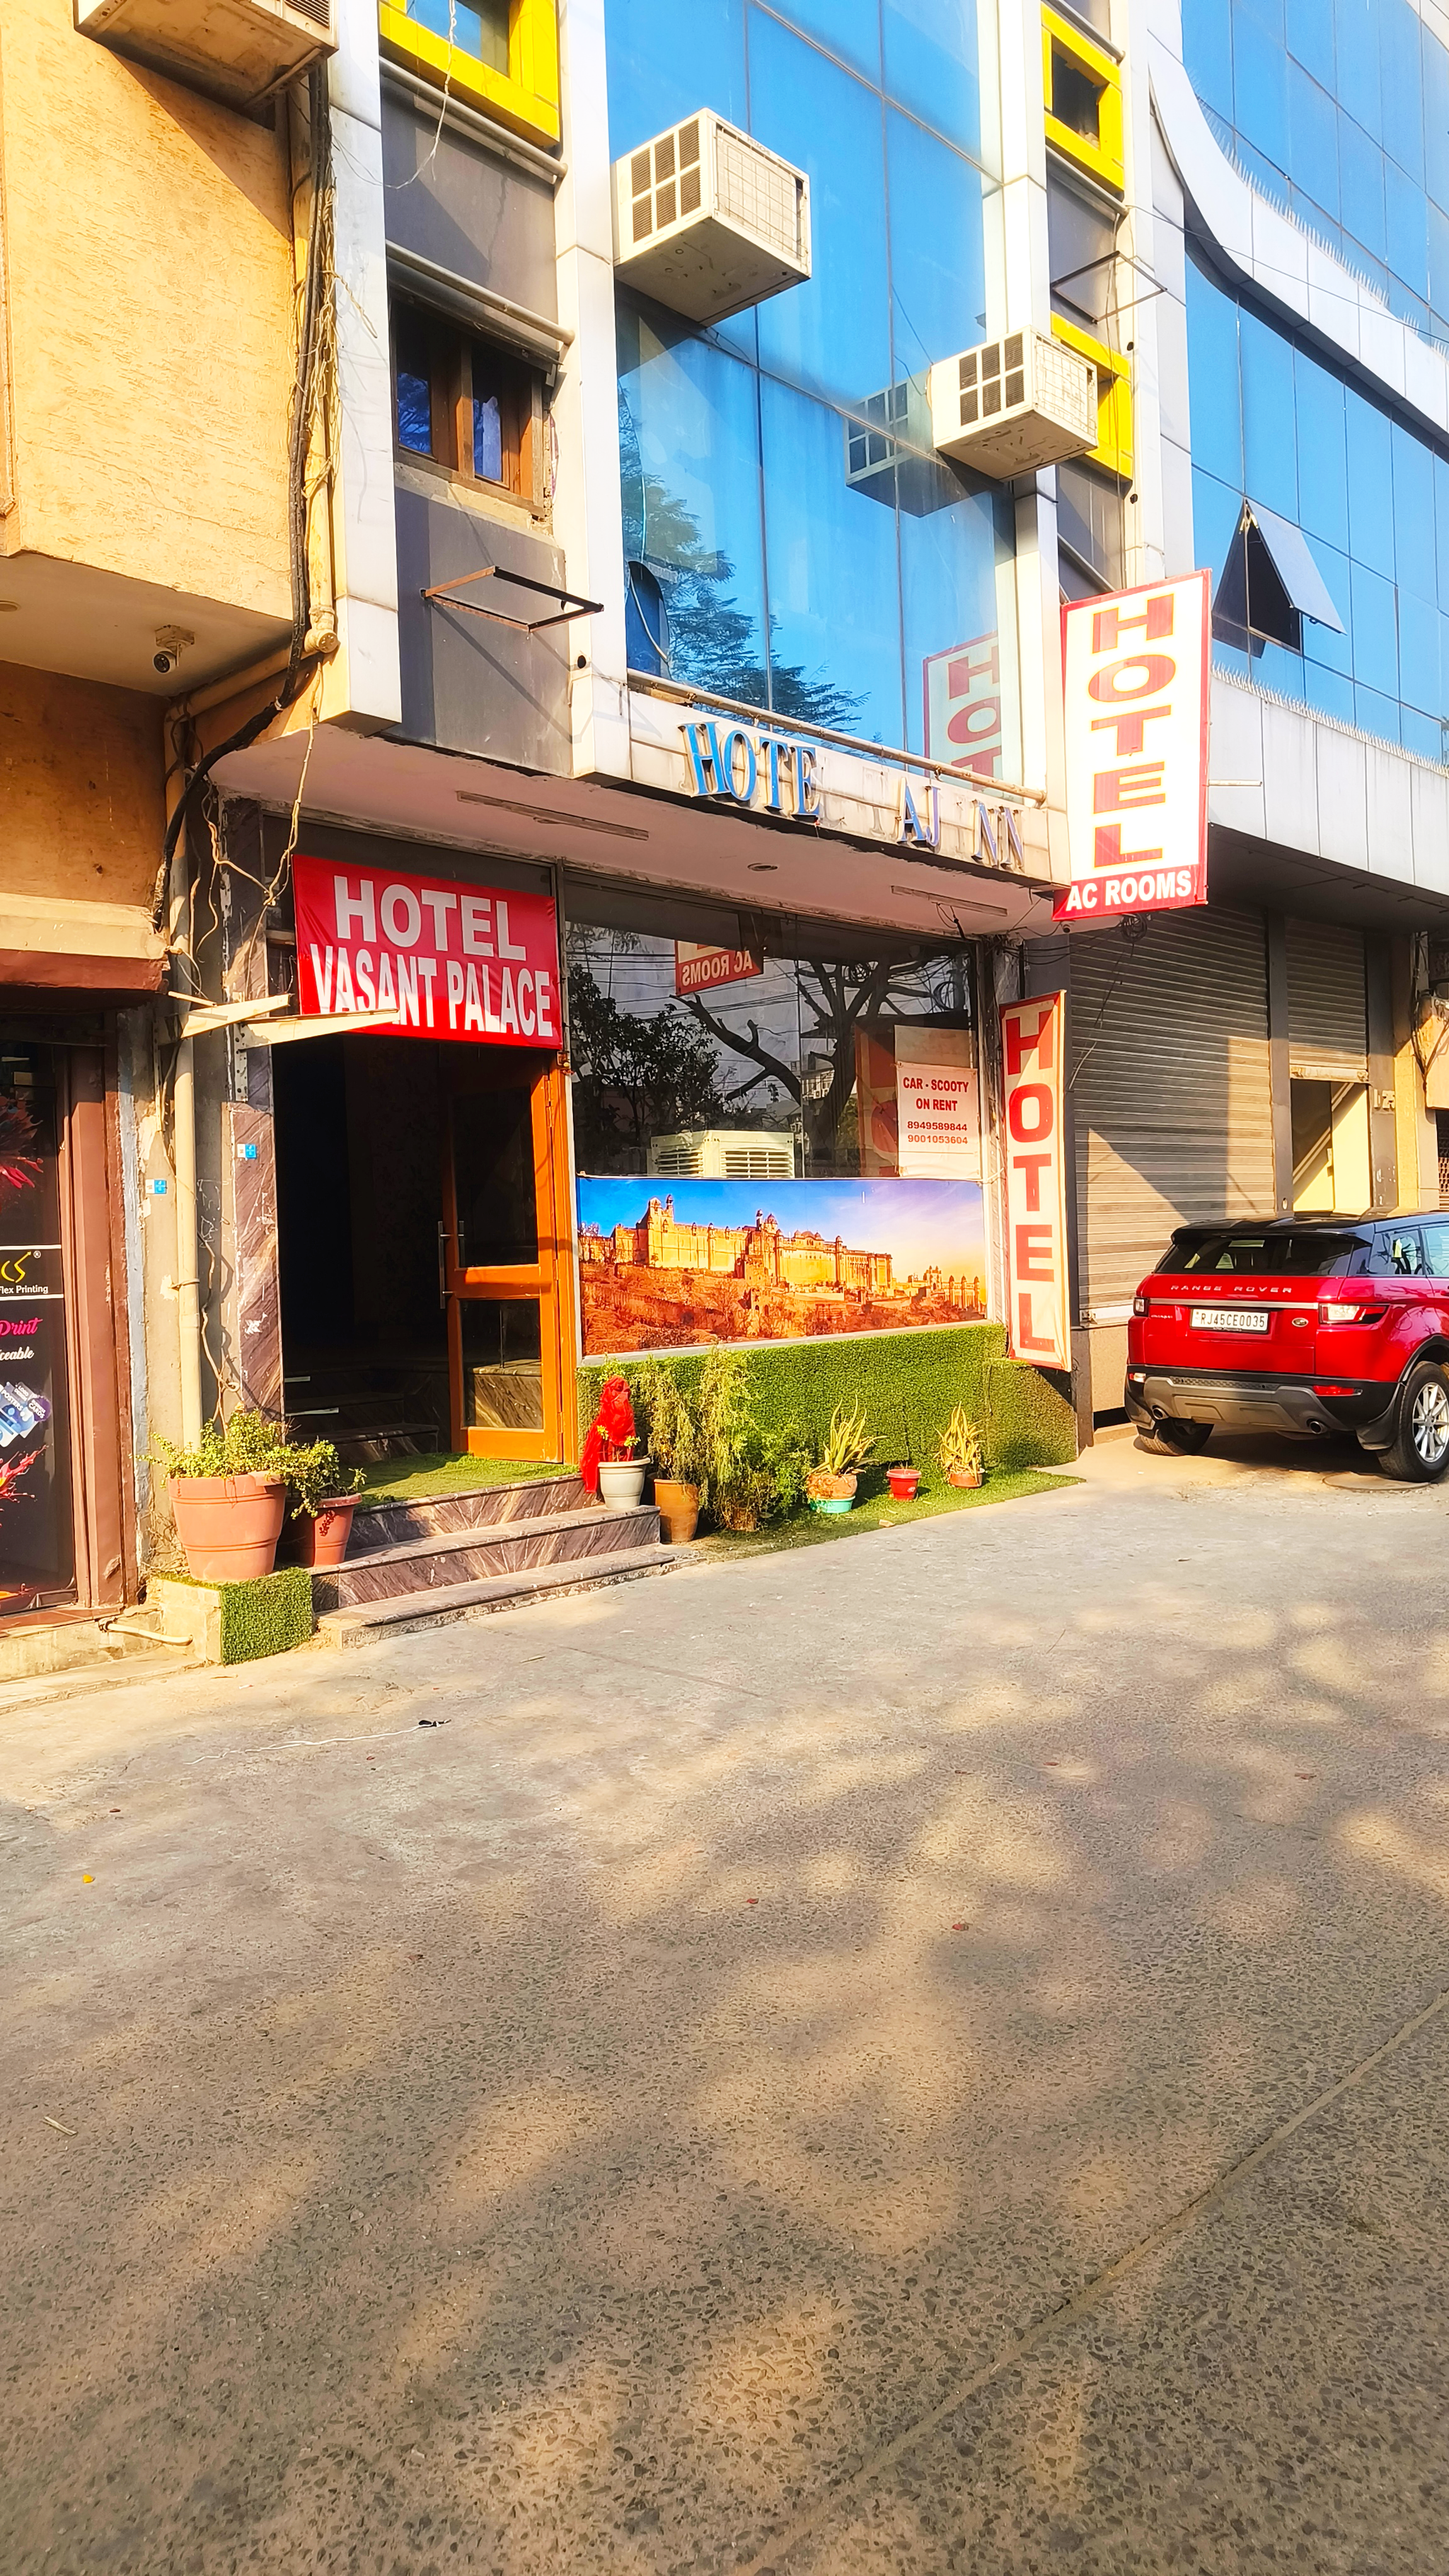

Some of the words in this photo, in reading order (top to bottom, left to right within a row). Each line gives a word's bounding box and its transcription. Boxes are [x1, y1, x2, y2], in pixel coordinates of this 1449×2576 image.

[1087, 593, 1176, 868] HOTEL
[1066, 882, 1097, 912] AC
[1104, 870, 1191, 906] ROOMS
[333, 874, 526, 961] HOTEL
[309, 943, 437, 1027] VASANT
[446, 959, 553, 1037] PALACE
[903, 1077, 923, 1090] CAR
[931, 1079, 969, 1092] SCOOTY
[916, 1098, 930, 1109] ON
[933, 1099, 957, 1111] RENT
[907, 1121, 967, 1131] 8949589844
[908, 1134, 968, 1144] 9001053604
[1005, 1010, 1055, 1353] HOTEL
[16, 1284, 49, 1294] Printing
[1201, 1312, 1265, 1328] RJ45CE0035
[1, 1389, 24, 1411] POSTERS
